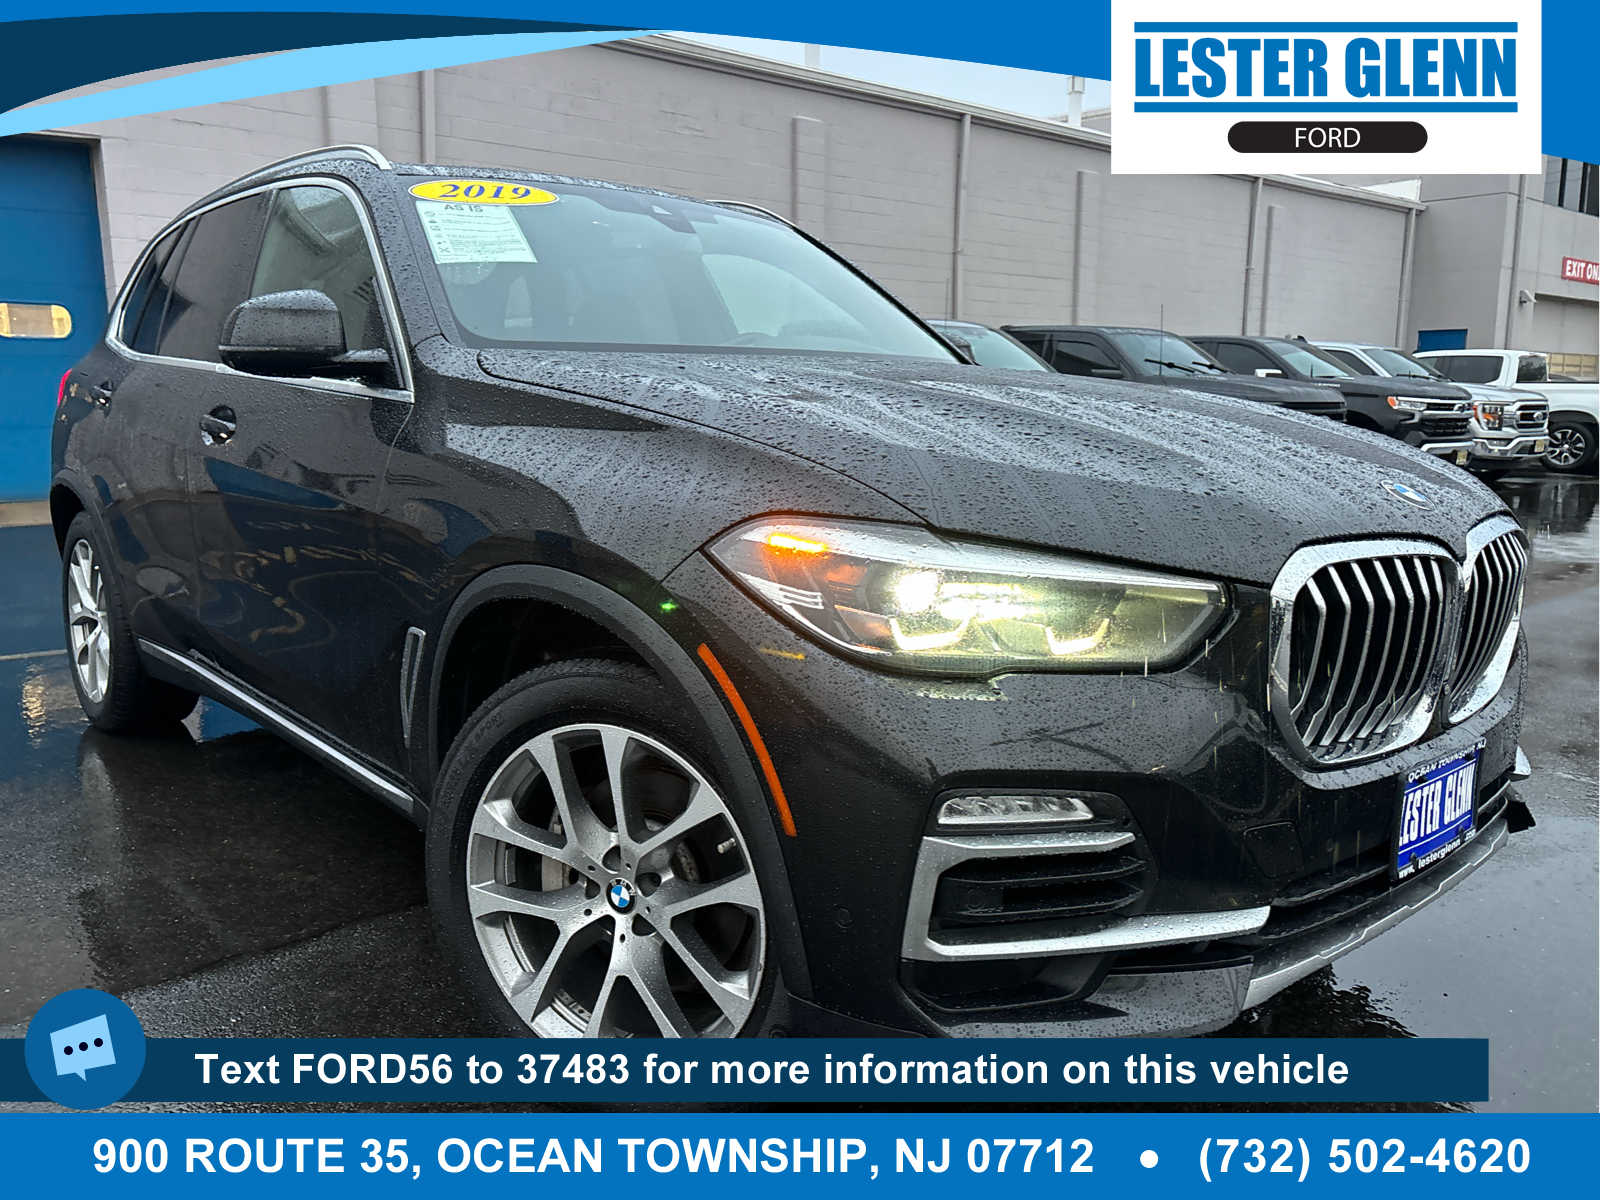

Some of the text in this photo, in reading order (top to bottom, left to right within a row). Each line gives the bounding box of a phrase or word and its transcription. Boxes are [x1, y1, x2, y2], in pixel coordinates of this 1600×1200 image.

[439, 183, 531, 200] 2019
[443, 203, 484, 213] AS IS
[1566, 260, 1585, 278] EXIT
[1408, 763, 1438, 783] OCEAN
[1476, 737, 1487, 750] NJ
[1399, 761, 1476, 847] LESTER GLENN
